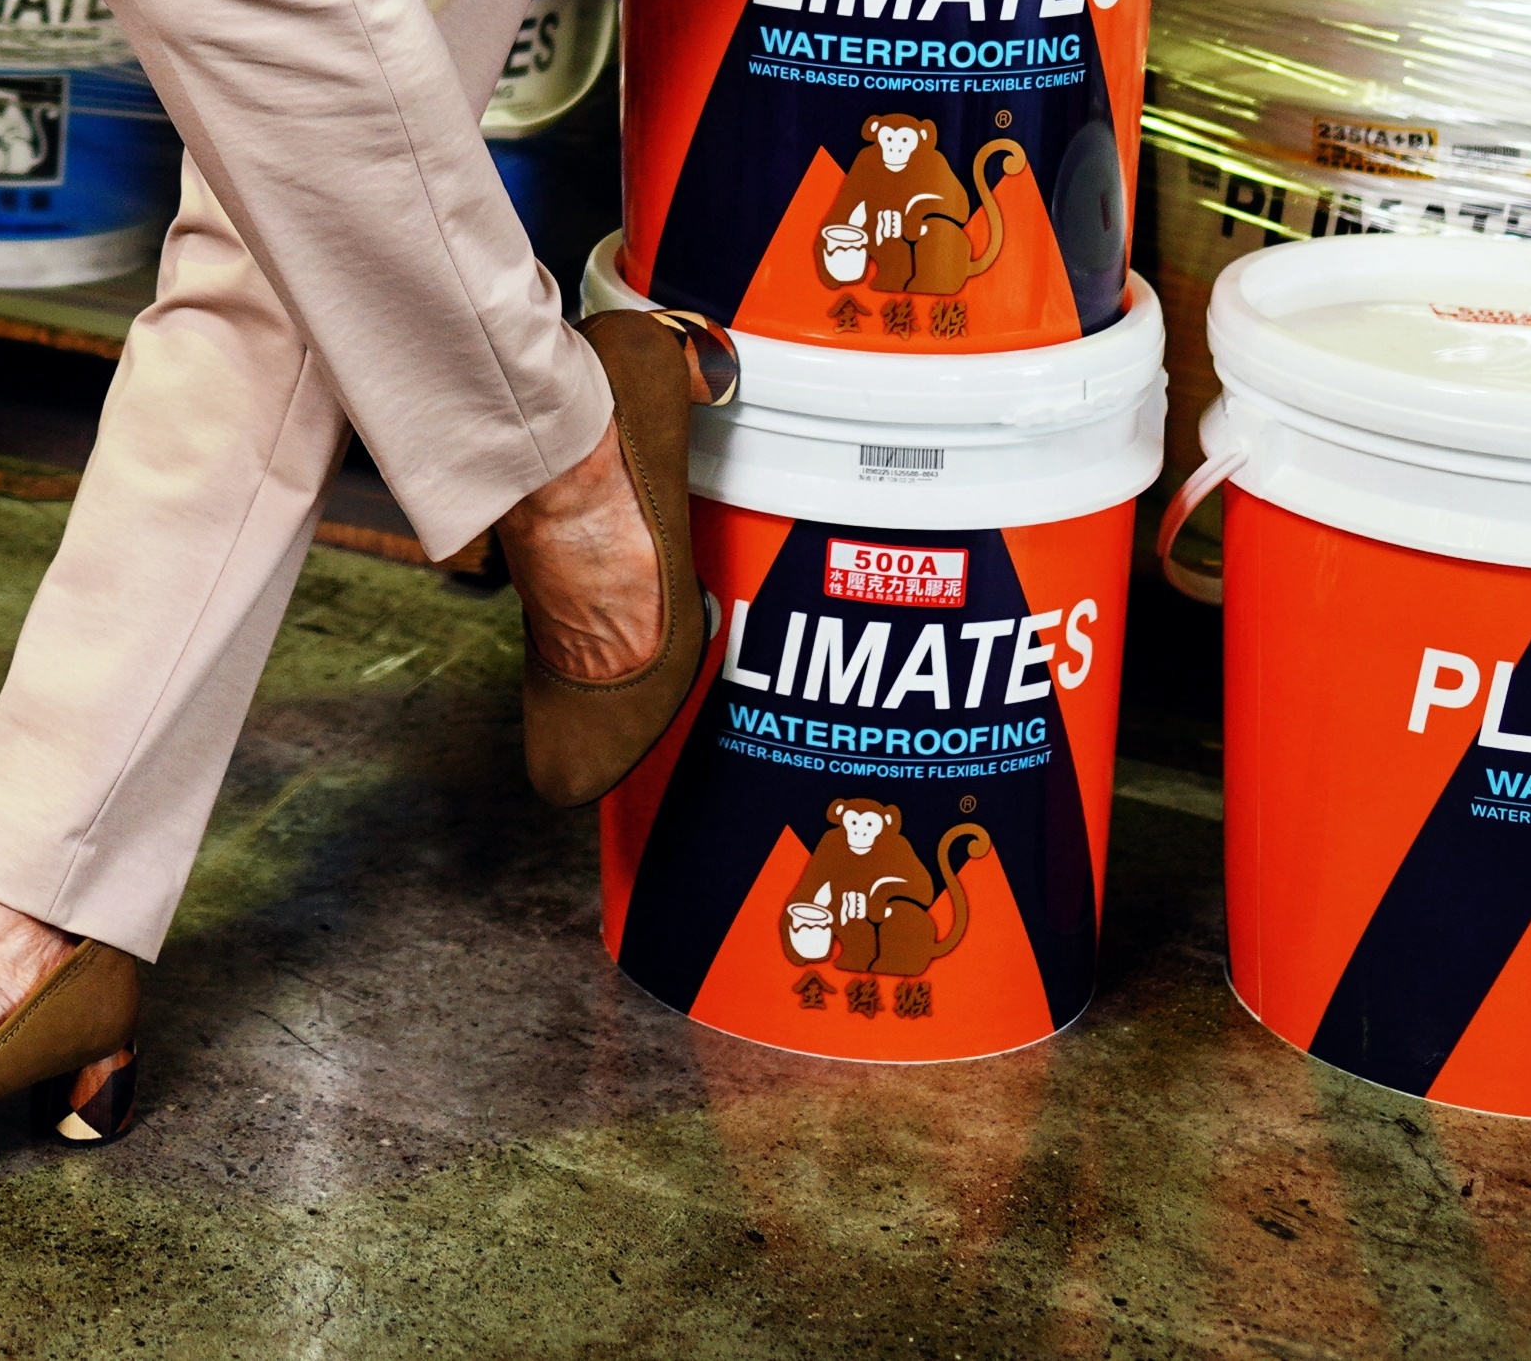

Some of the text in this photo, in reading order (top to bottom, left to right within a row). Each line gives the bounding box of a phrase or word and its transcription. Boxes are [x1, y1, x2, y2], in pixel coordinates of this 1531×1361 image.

[760, 26, 1080, 68] WATERPROOFING
[854, 549, 938, 575] 500A
[706, 590, 1100, 710] LIMATES
[727, 703, 1046, 755] WATERPROOFING
